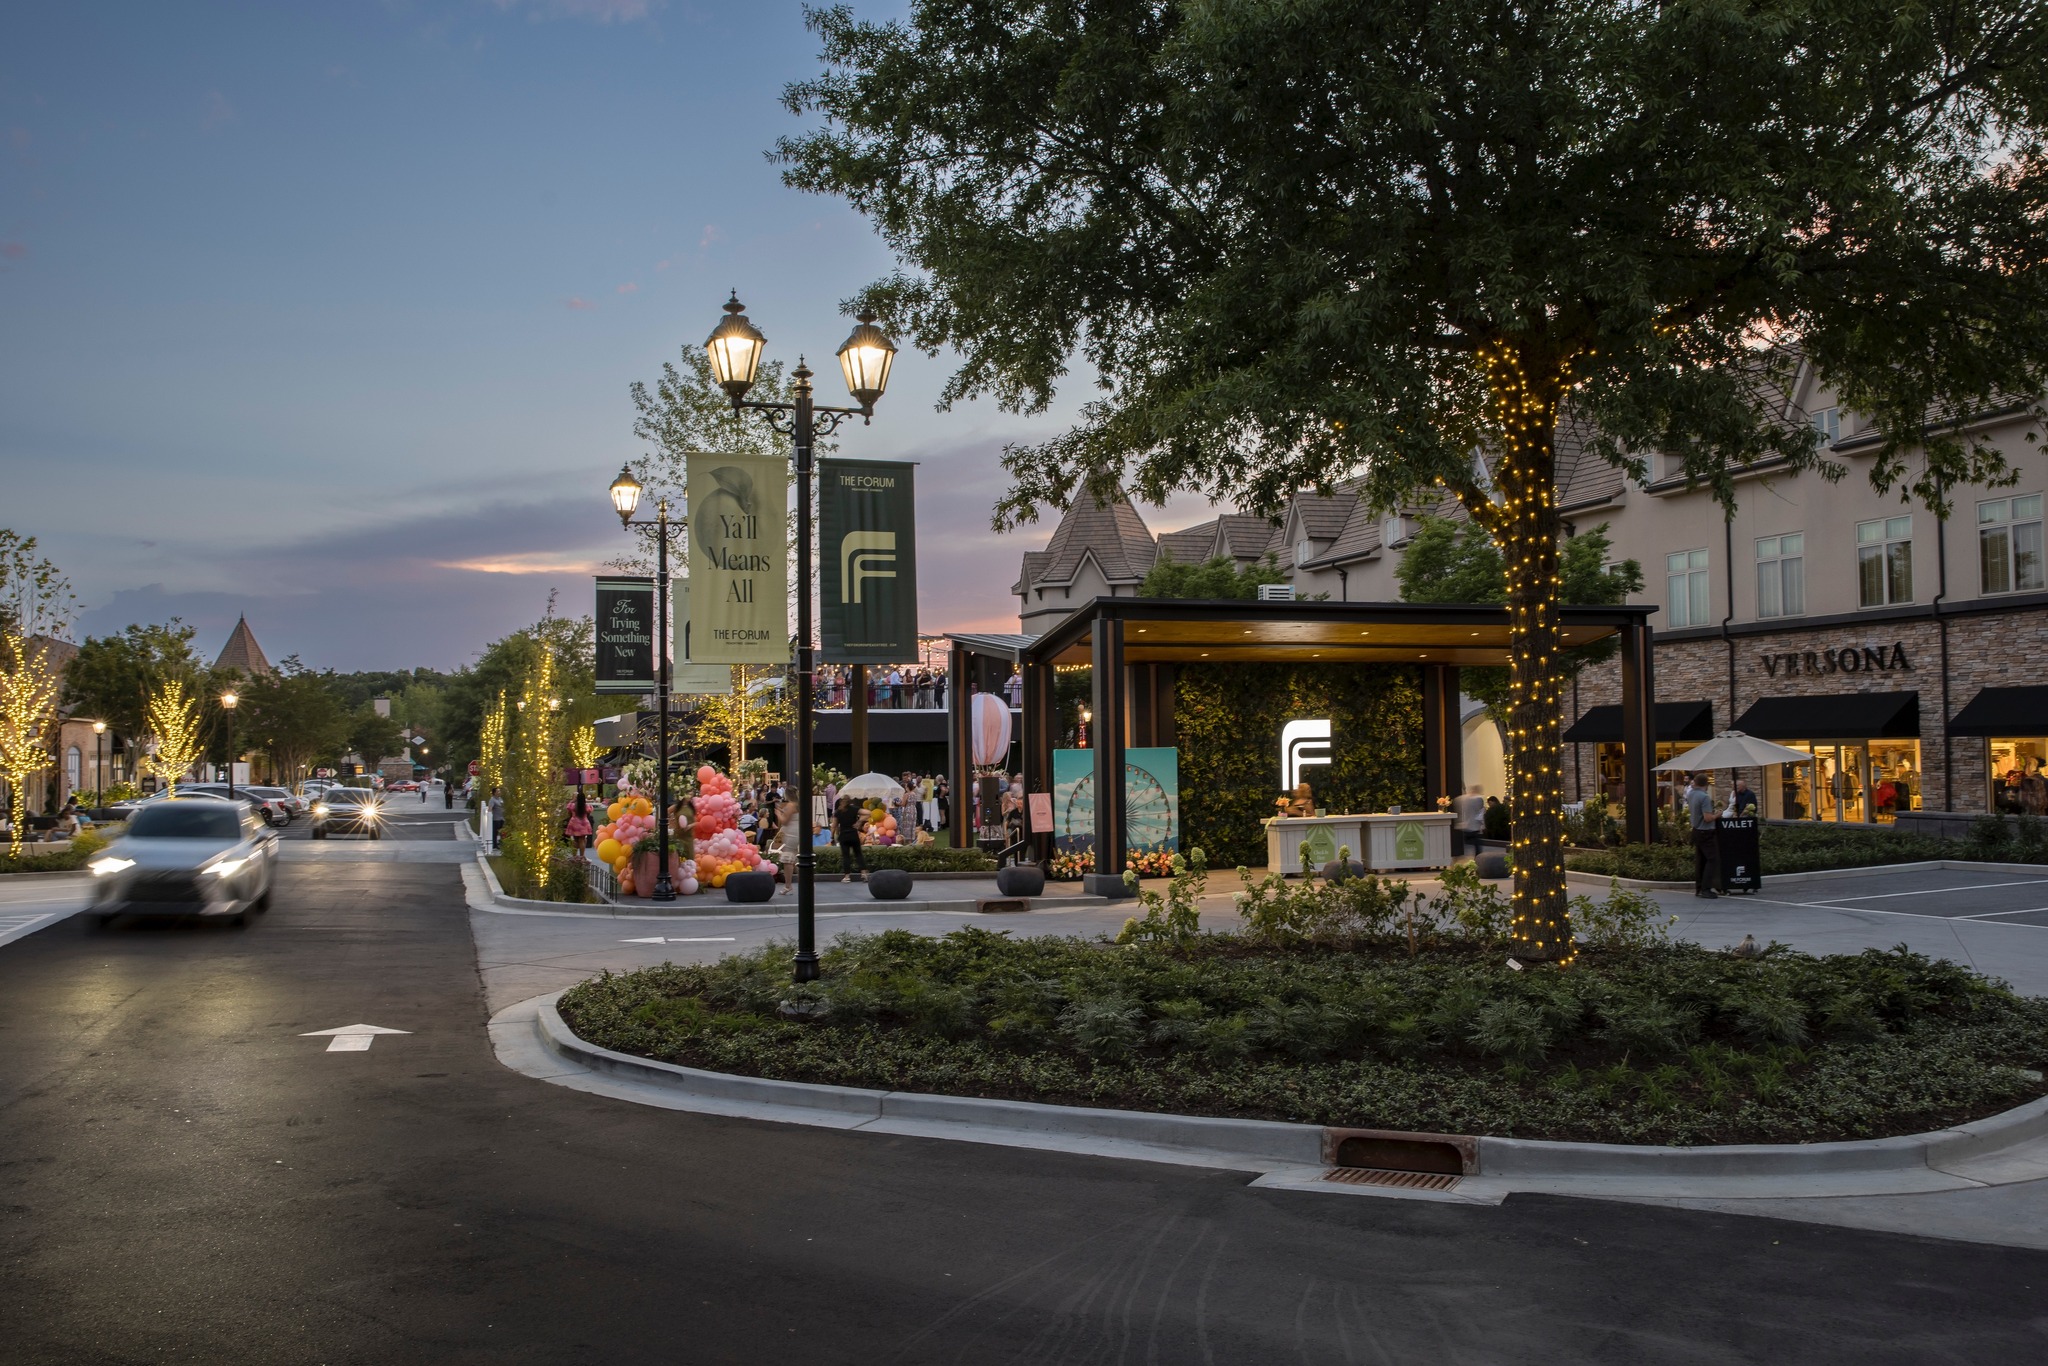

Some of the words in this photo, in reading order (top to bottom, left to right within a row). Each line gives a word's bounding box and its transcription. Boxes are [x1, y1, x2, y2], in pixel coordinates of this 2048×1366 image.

[840, 475, 856, 486] THE
[857, 476, 895, 488] FORUM
[719, 514, 757, 540] Ya'll
[707, 546, 771, 572] Means
[726, 579, 754, 603] All
[612, 599, 637, 614] For
[609, 616, 641, 632] Trying
[600, 630, 651, 647] Something
[713, 629, 730, 640] THE
[731, 629, 770, 641] FORUM
[614, 645, 637, 658] New
[1760, 640, 1911, 678] VERSONA
[1721, 819, 1754, 829] VALET
